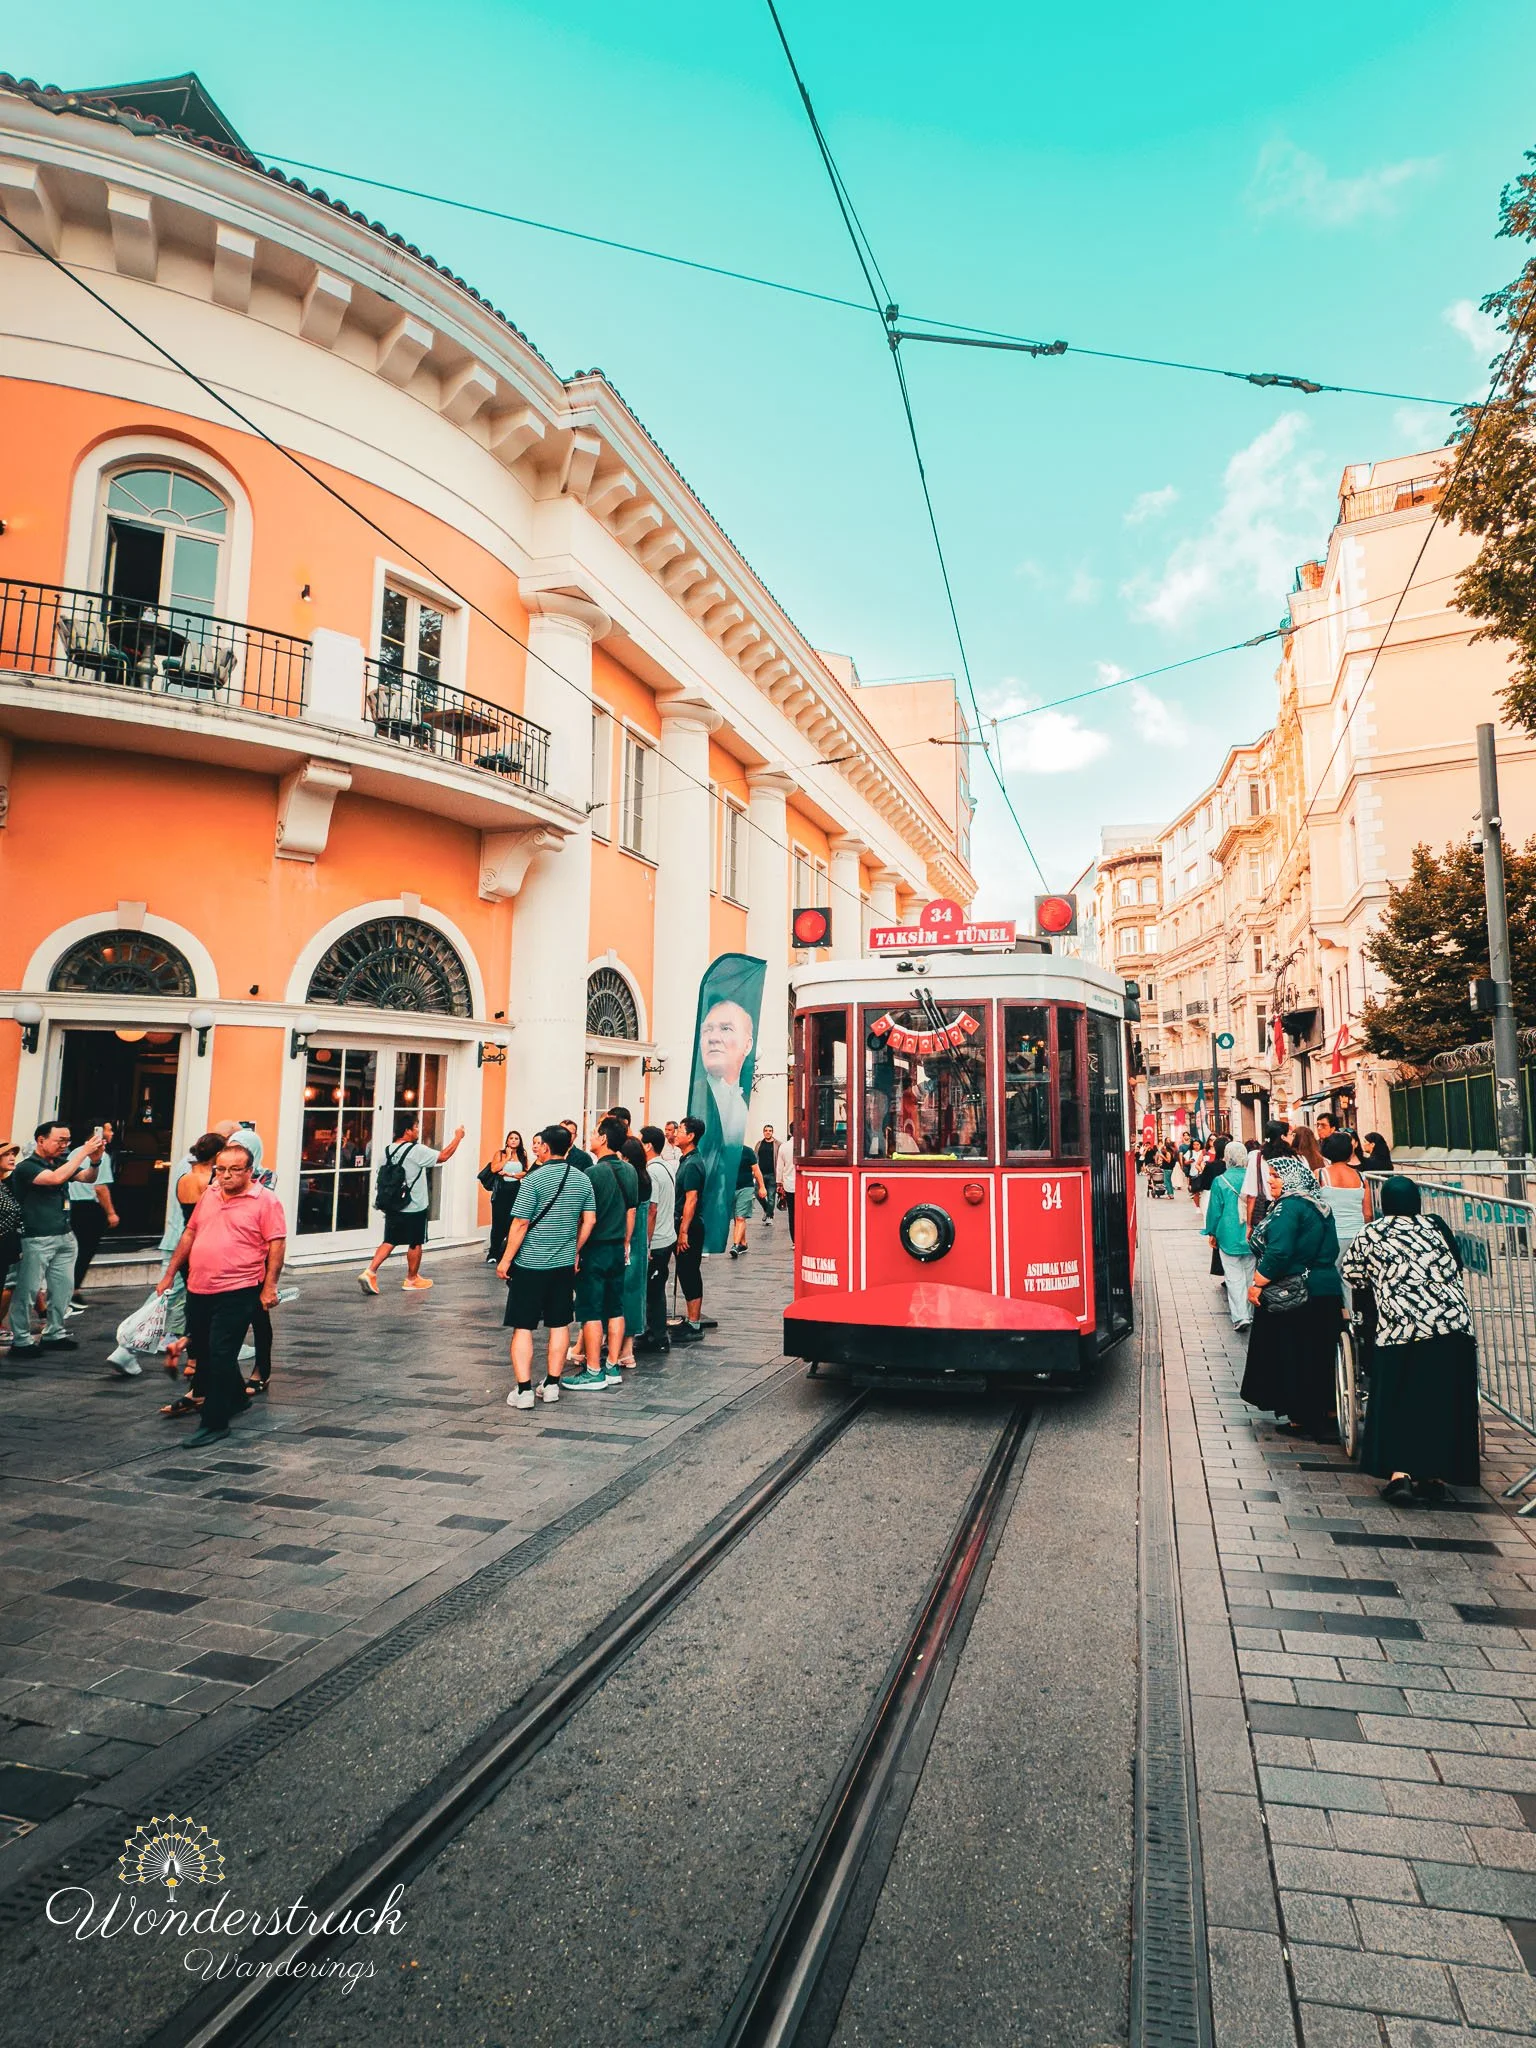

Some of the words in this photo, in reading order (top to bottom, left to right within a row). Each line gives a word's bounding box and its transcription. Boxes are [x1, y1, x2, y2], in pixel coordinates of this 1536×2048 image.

[930, 907, 953, 923] 34
[875, 927, 938, 946] TAKSİM
[955, 925, 1009, 943] TÜNEL
[807, 1180, 820, 1207] 34
[1041, 1181, 1063, 1210] 34
